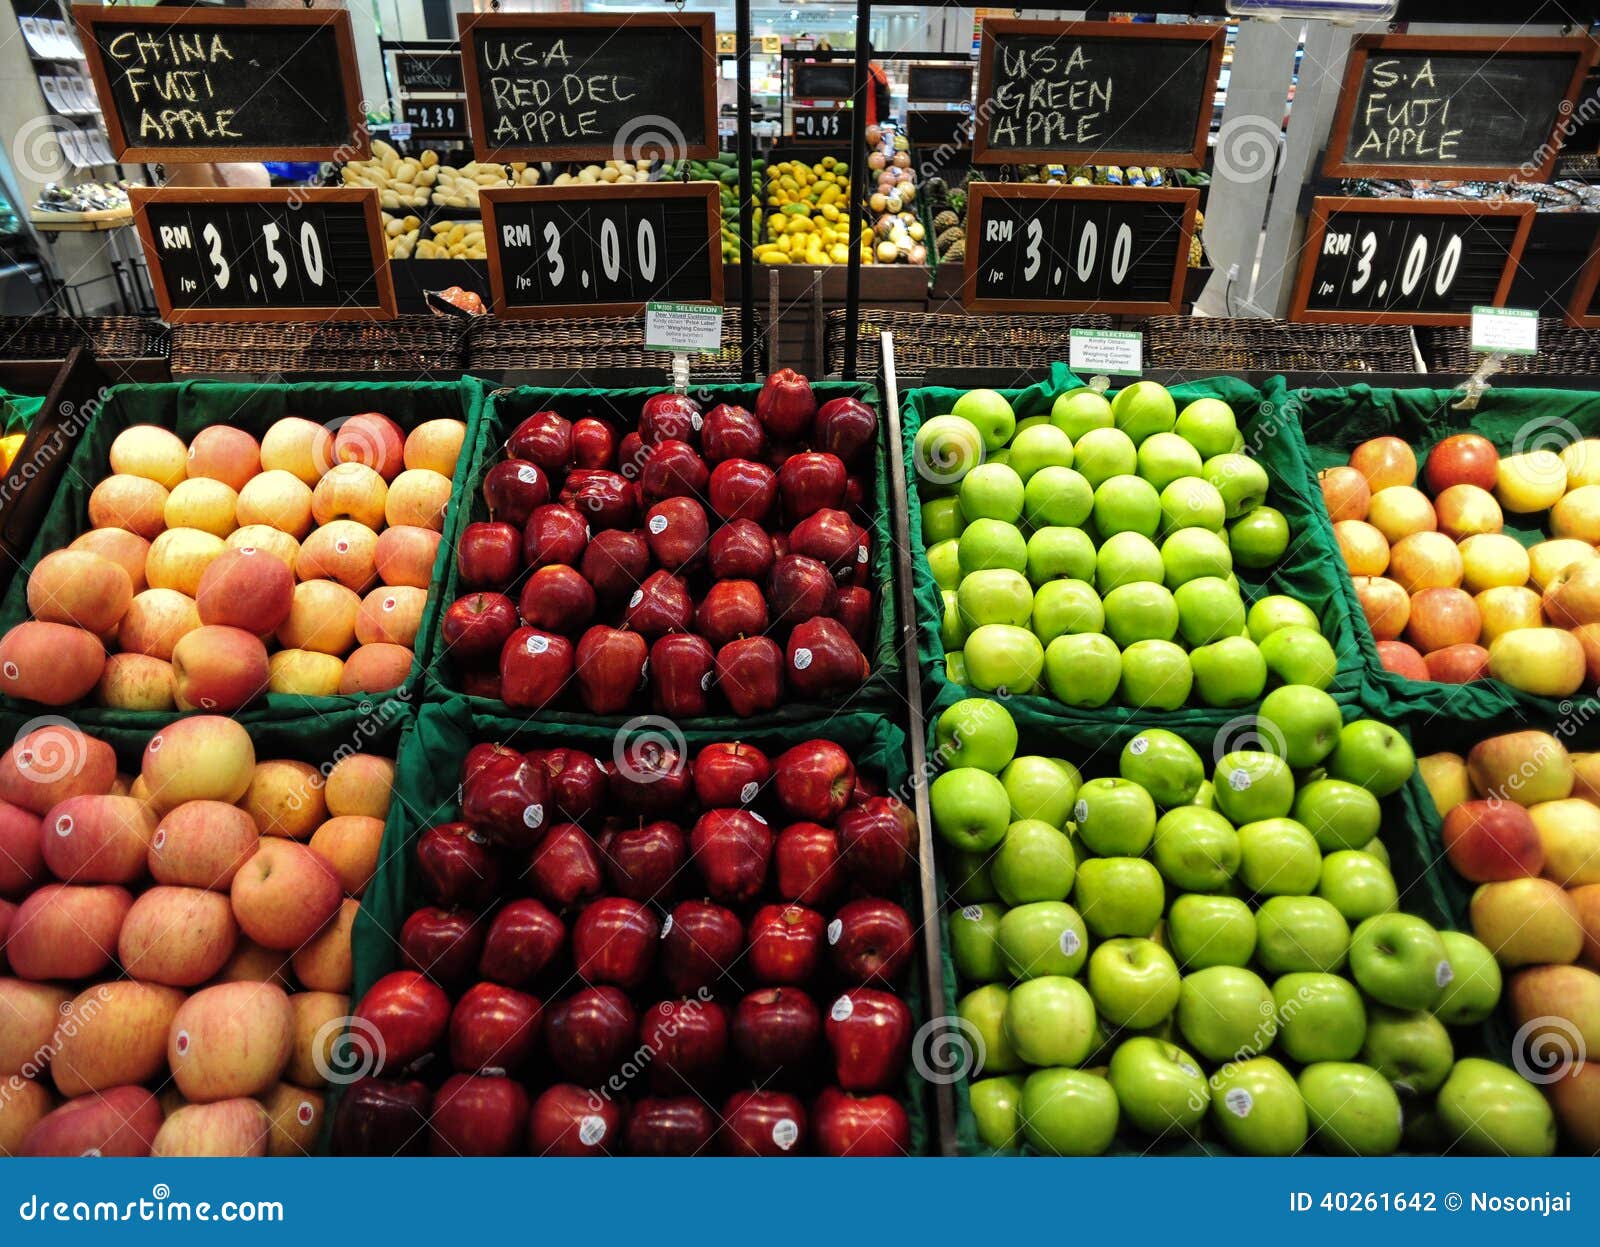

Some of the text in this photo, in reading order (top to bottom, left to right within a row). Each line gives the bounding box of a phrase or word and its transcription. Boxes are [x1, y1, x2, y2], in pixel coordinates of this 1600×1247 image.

[110, 33, 233, 65] CHINA
[126, 67, 214, 102] FUJI
[1373, 59, 1435, 89] S.A
[491, 74, 636, 110] RED DEL
[997, 77, 1114, 115] GREEN
[140, 108, 242, 140] APPLE
[494, 110, 605, 142] APPLE
[1365, 94, 1451, 127] FUJI
[993, 112, 1104, 146] APPLE
[1354, 129, 1463, 159] APPLE
[160, 221, 324, 293] RM 3.50
[503, 218, 657, 289] RM 3.00
[986, 217, 1132, 286] RM 3.00
[1323, 232, 1462, 298] RM 3.00
[180, 276, 197, 291] /pc
[516, 275, 532, 290] /pc
[988, 268, 1004, 283] /pc
[1317, 282, 1335, 296] /pc
[676, 305, 717, 313] SELECTION
